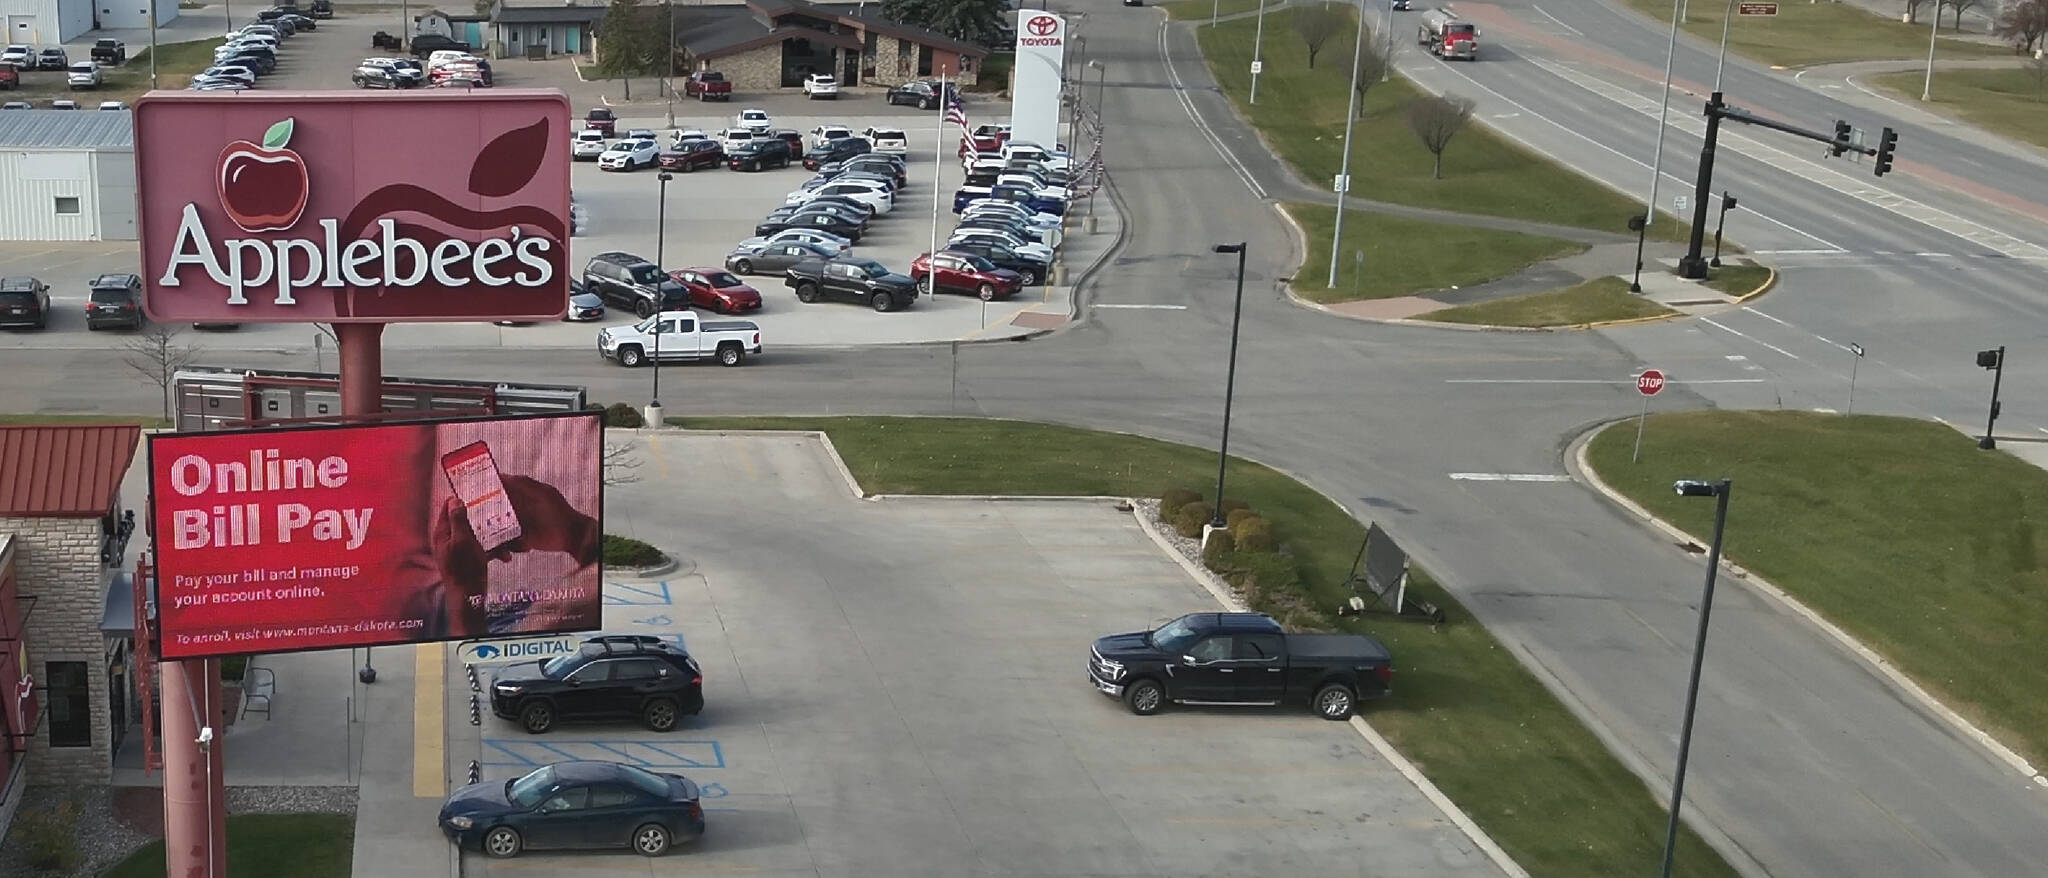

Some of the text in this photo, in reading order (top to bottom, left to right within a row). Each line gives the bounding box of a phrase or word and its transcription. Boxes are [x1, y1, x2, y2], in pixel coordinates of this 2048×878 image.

[1020, 38, 1062, 46] TOYOTA
[159, 202, 554, 305] Applebee's
[1639, 377, 1663, 388] STOP
[171, 448, 348, 496] Online
[173, 503, 374, 550] Bill Pay
[175, 565, 360, 589] Pay your bill and manage
[174, 594, 207, 609] your
[177, 634, 190, 644] To
